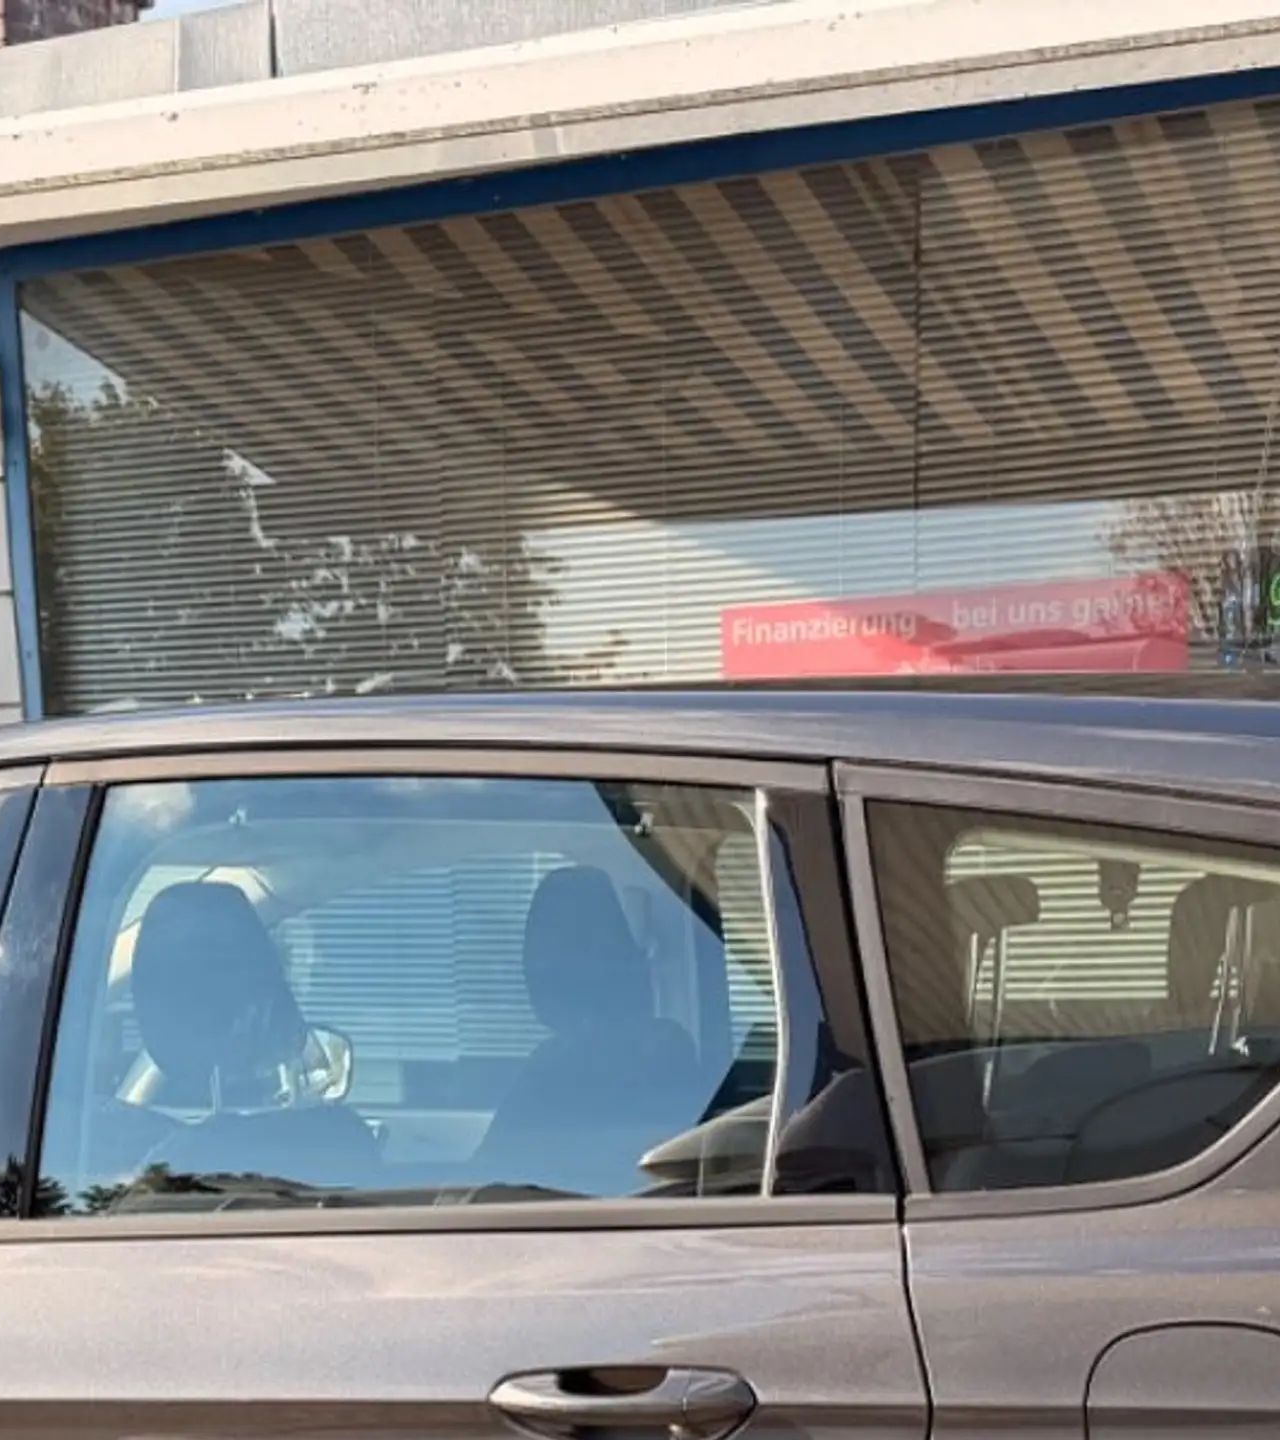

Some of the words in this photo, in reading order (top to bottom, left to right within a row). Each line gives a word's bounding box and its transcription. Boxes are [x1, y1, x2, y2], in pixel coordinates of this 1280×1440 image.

[732, 612, 917, 646] Finanzierung
[952, 597, 997, 629] bei
[1008, 600, 1064, 626] uns
